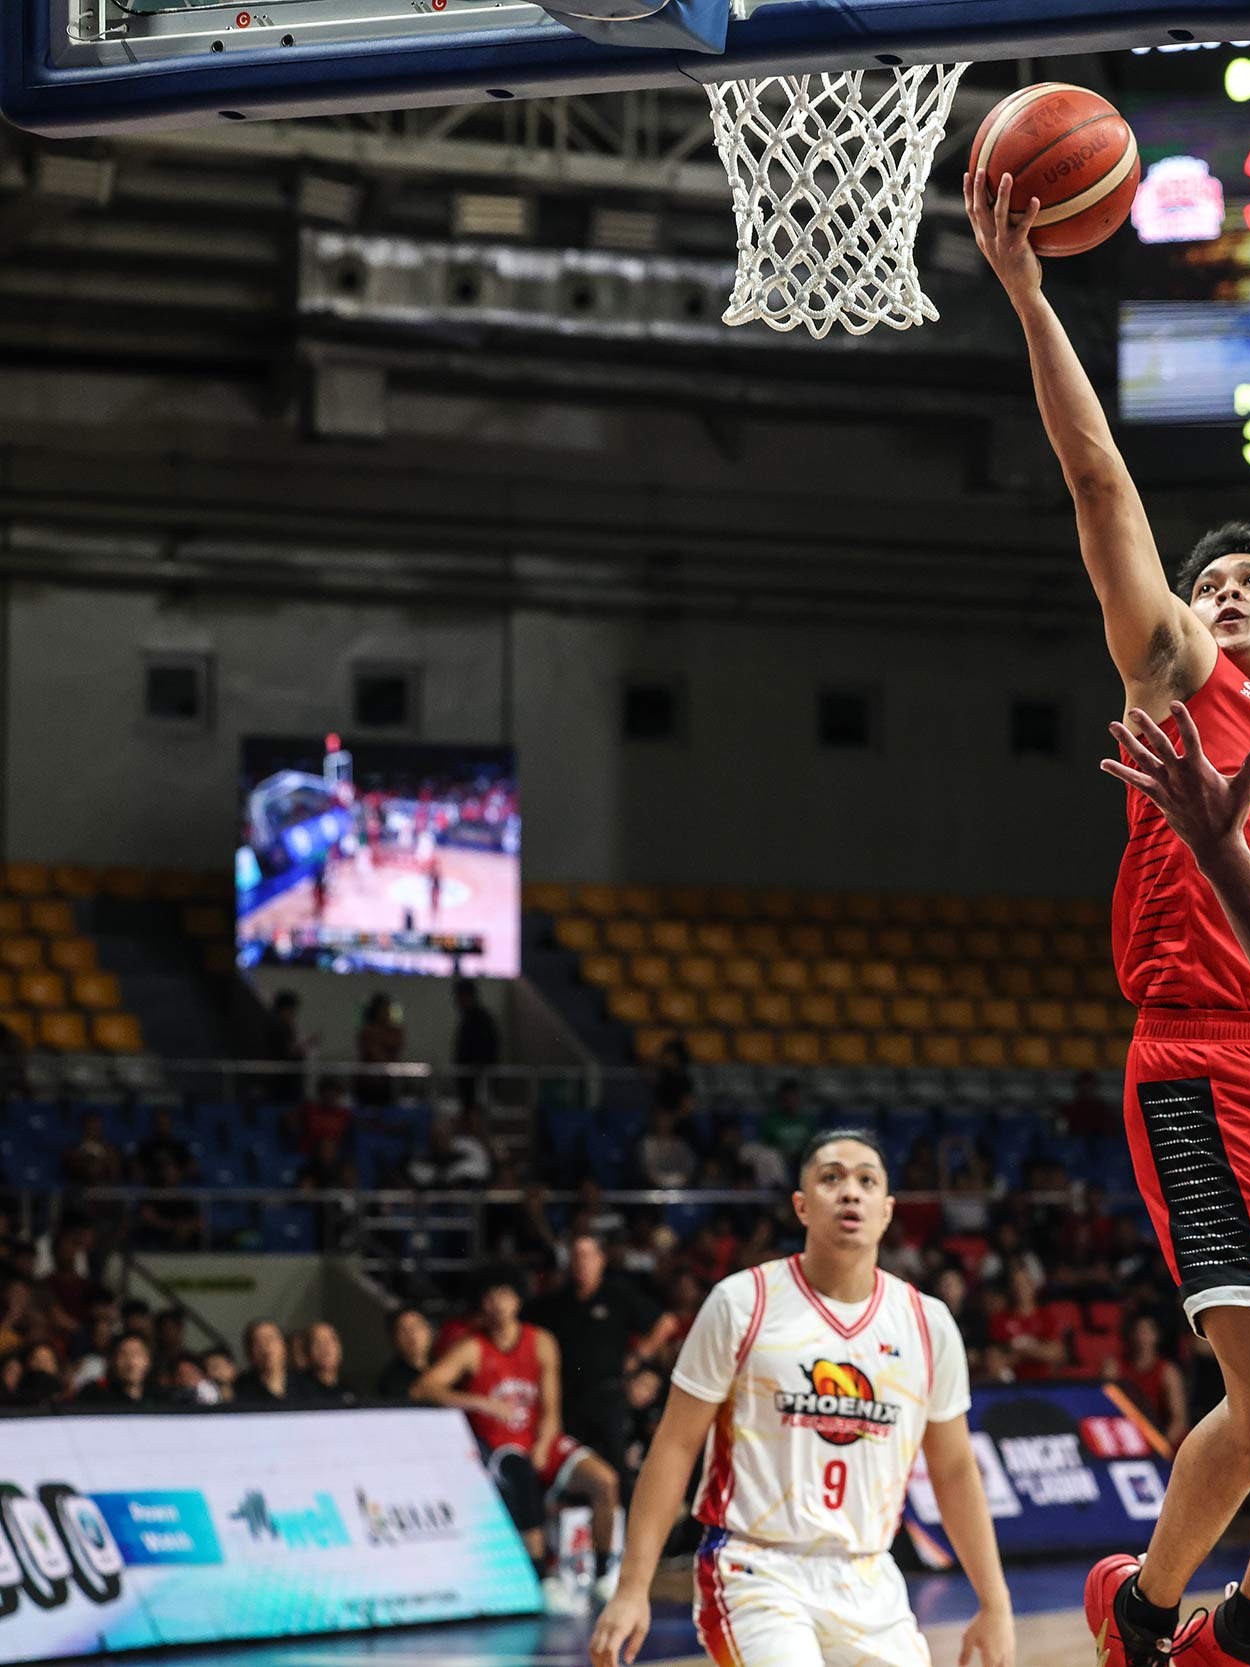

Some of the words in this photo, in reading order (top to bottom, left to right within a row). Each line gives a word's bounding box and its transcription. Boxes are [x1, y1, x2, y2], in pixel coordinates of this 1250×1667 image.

[1043, 131, 1109, 184] molten
[774, 1390, 900, 1424] PHOENIX
[823, 1459, 848, 1510] 9
